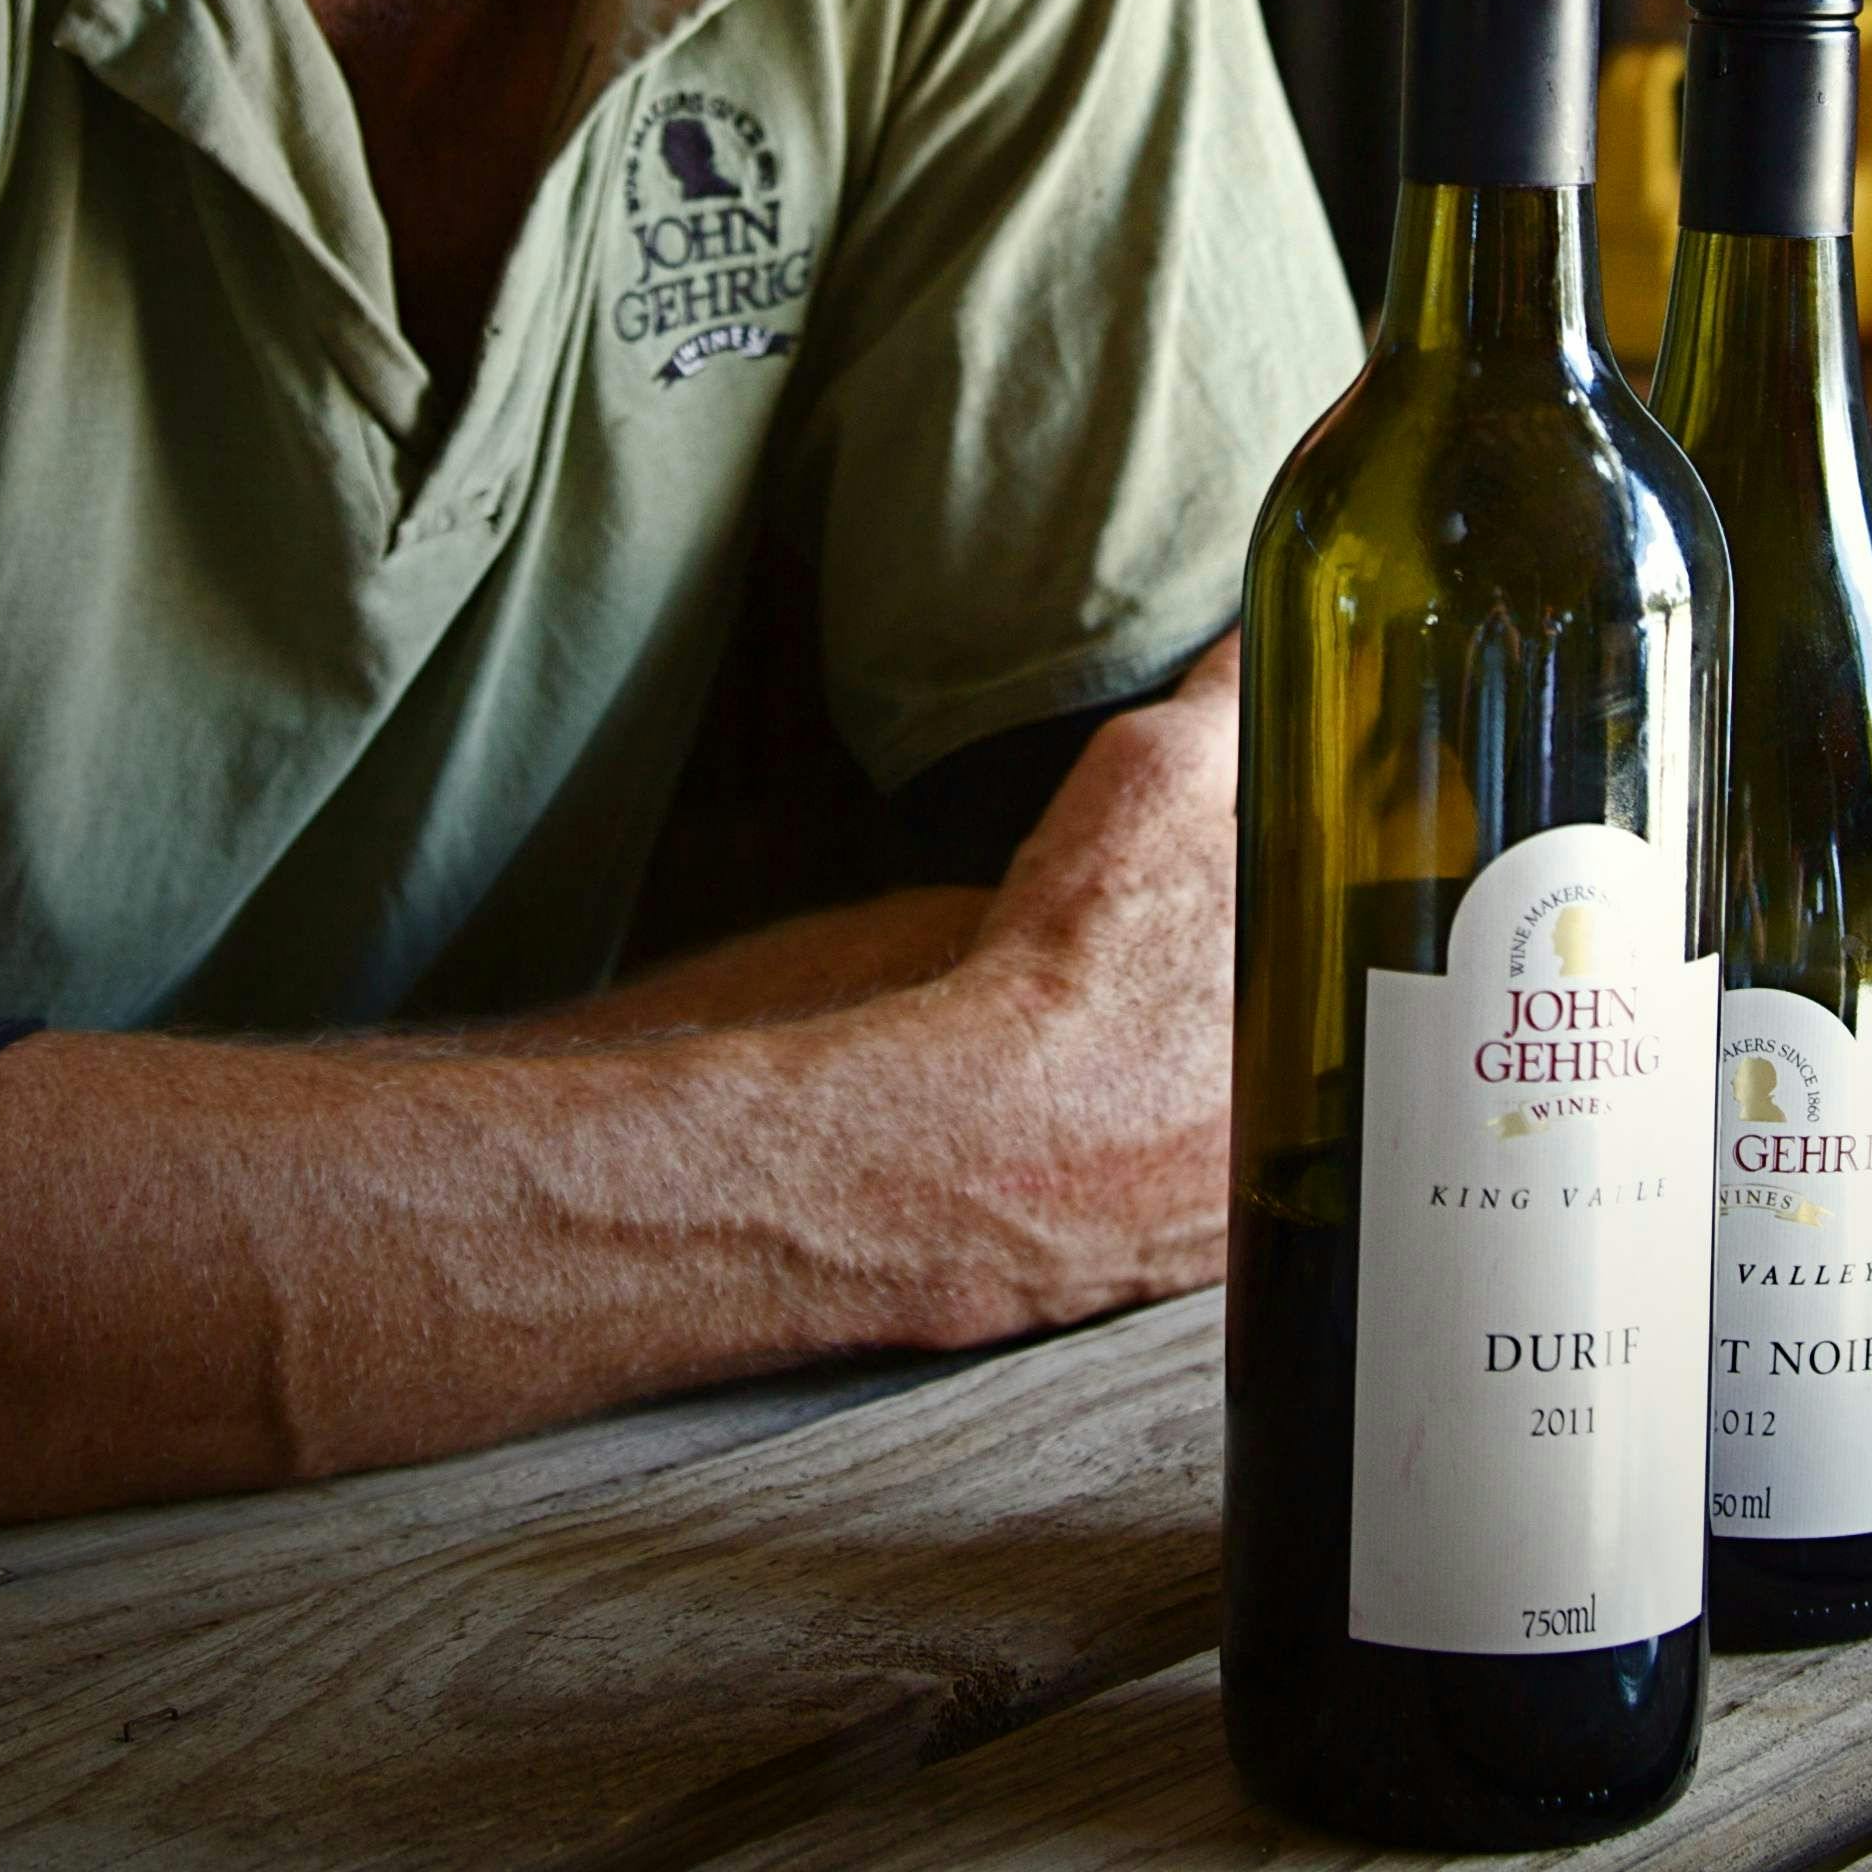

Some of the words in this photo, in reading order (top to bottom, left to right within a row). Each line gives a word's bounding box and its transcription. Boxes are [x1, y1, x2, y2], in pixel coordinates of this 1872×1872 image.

[631, 199, 781, 284] JOHN
[612, 238, 815, 344] GEHRIG
[1509, 927, 1532, 978] WINE
[1524, 885, 1596, 927] MAKERS
[1502, 986, 1639, 1039] JOHN
[1474, 1034, 1661, 1083] GEHRIG
[1722, 1037, 1776, 1063] AKERS
[1778, 1043, 1818, 1088] SINCE
[1807, 1090, 1821, 1123] 1860
[1429, 1184, 1530, 1210] KING
[1561, 1177, 1668, 1209] VALLE
[1484, 1326, 1641, 1372] DURIF
[1530, 1406, 1596, 1437] 2011
[1715, 1409, 1776, 1436] 012
[1522, 1591, 1596, 1639] 750ml
